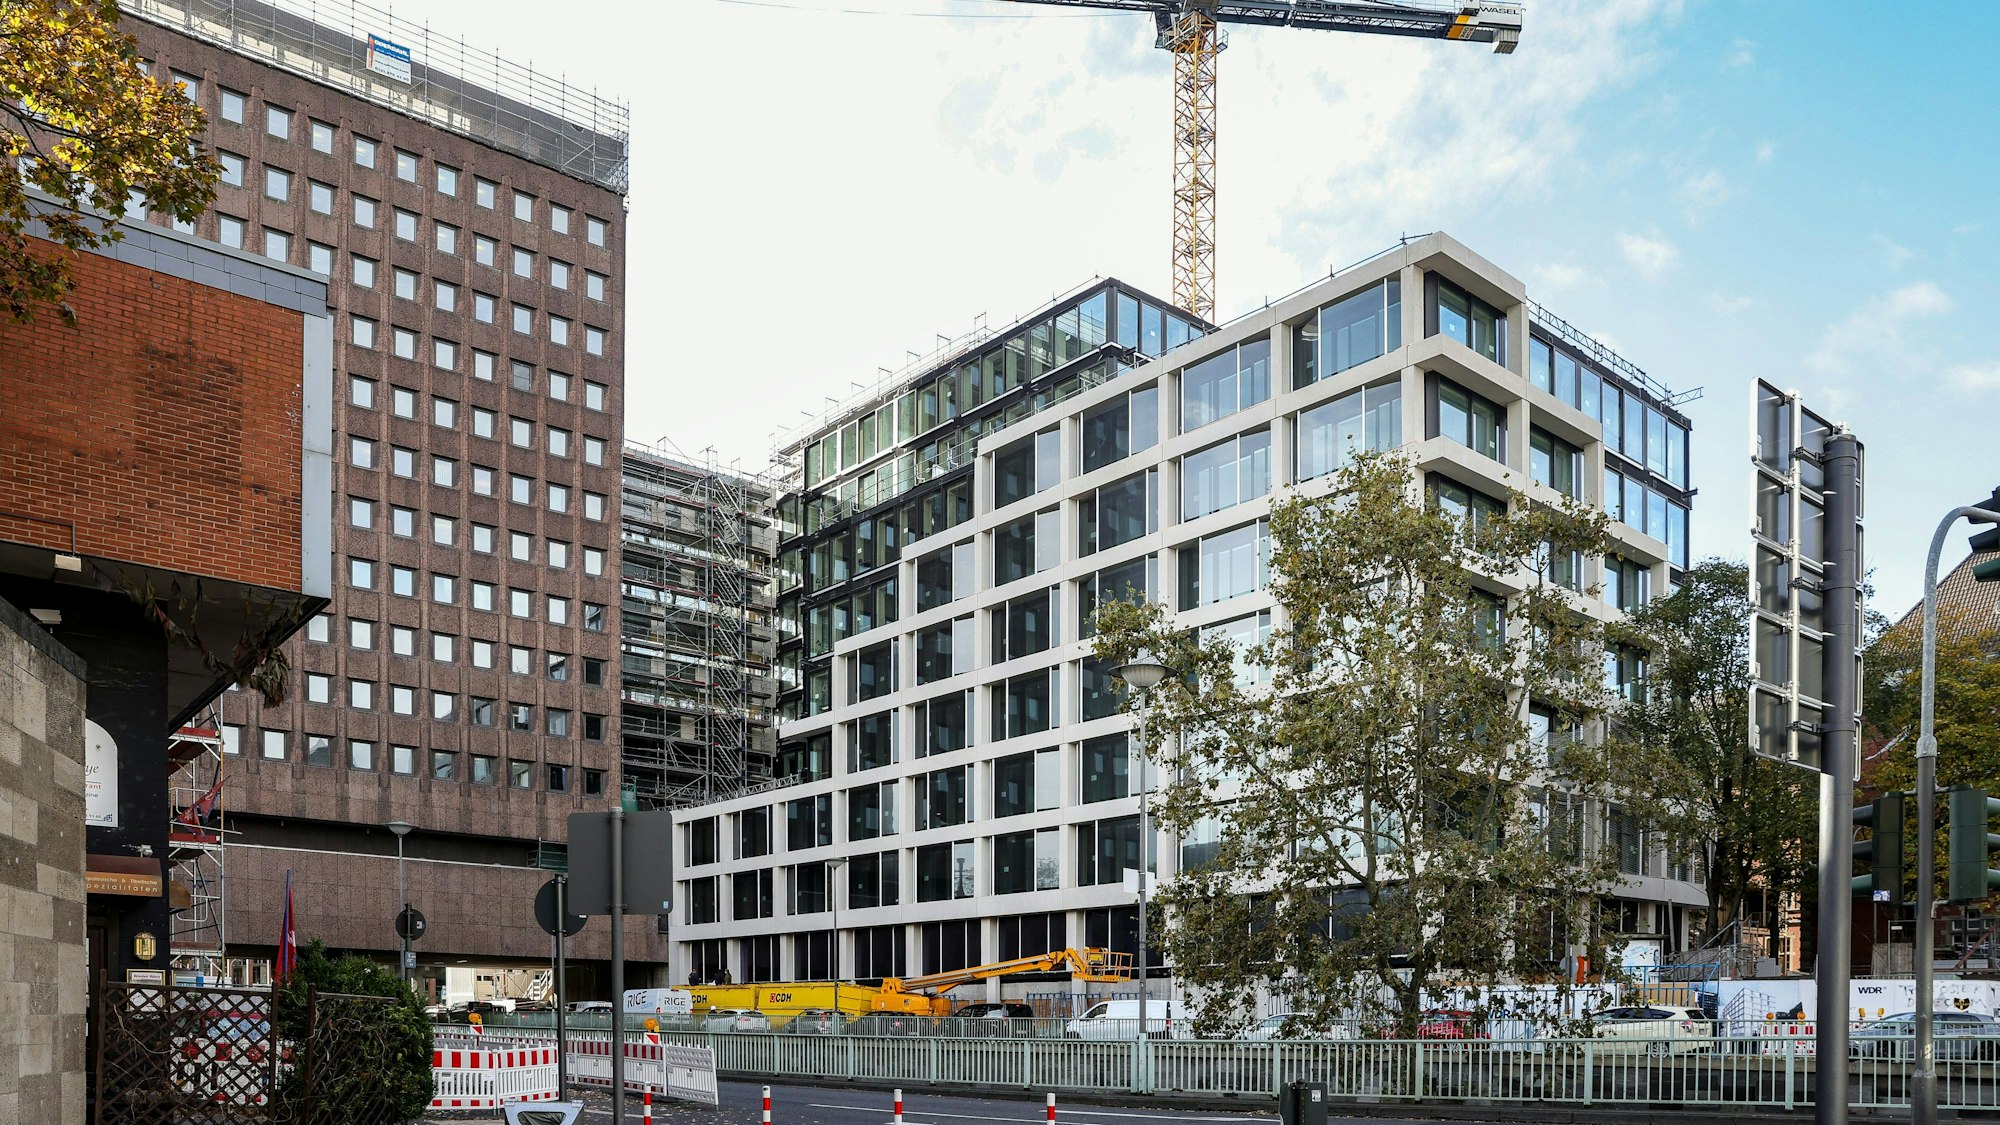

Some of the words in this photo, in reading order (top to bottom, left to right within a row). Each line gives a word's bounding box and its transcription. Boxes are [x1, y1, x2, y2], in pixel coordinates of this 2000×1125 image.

[1480, 7, 1520, 15] WASEL
[627, 990, 647, 1008] RIGE
[664, 997, 686, 1006] RIGE
